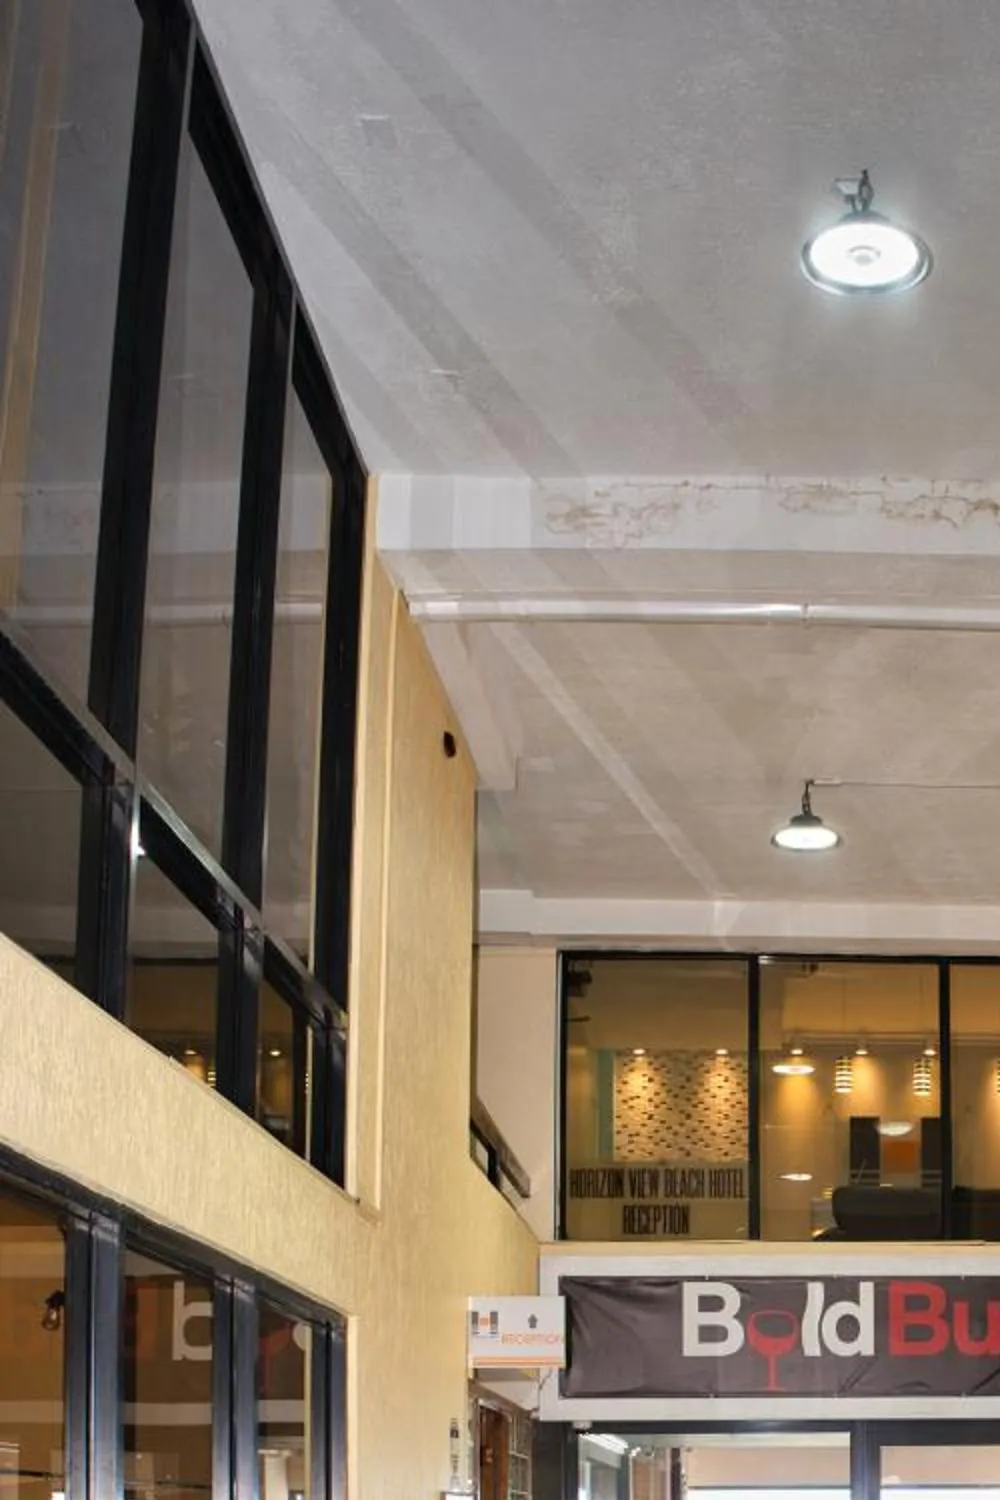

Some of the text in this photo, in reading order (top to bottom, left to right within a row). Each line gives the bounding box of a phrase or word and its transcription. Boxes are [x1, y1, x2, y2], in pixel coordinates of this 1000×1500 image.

[569, 1168, 746, 1198] HORIZON VIEW BEACH HOTEL
[622, 1204, 690, 1235] RECEPTION
